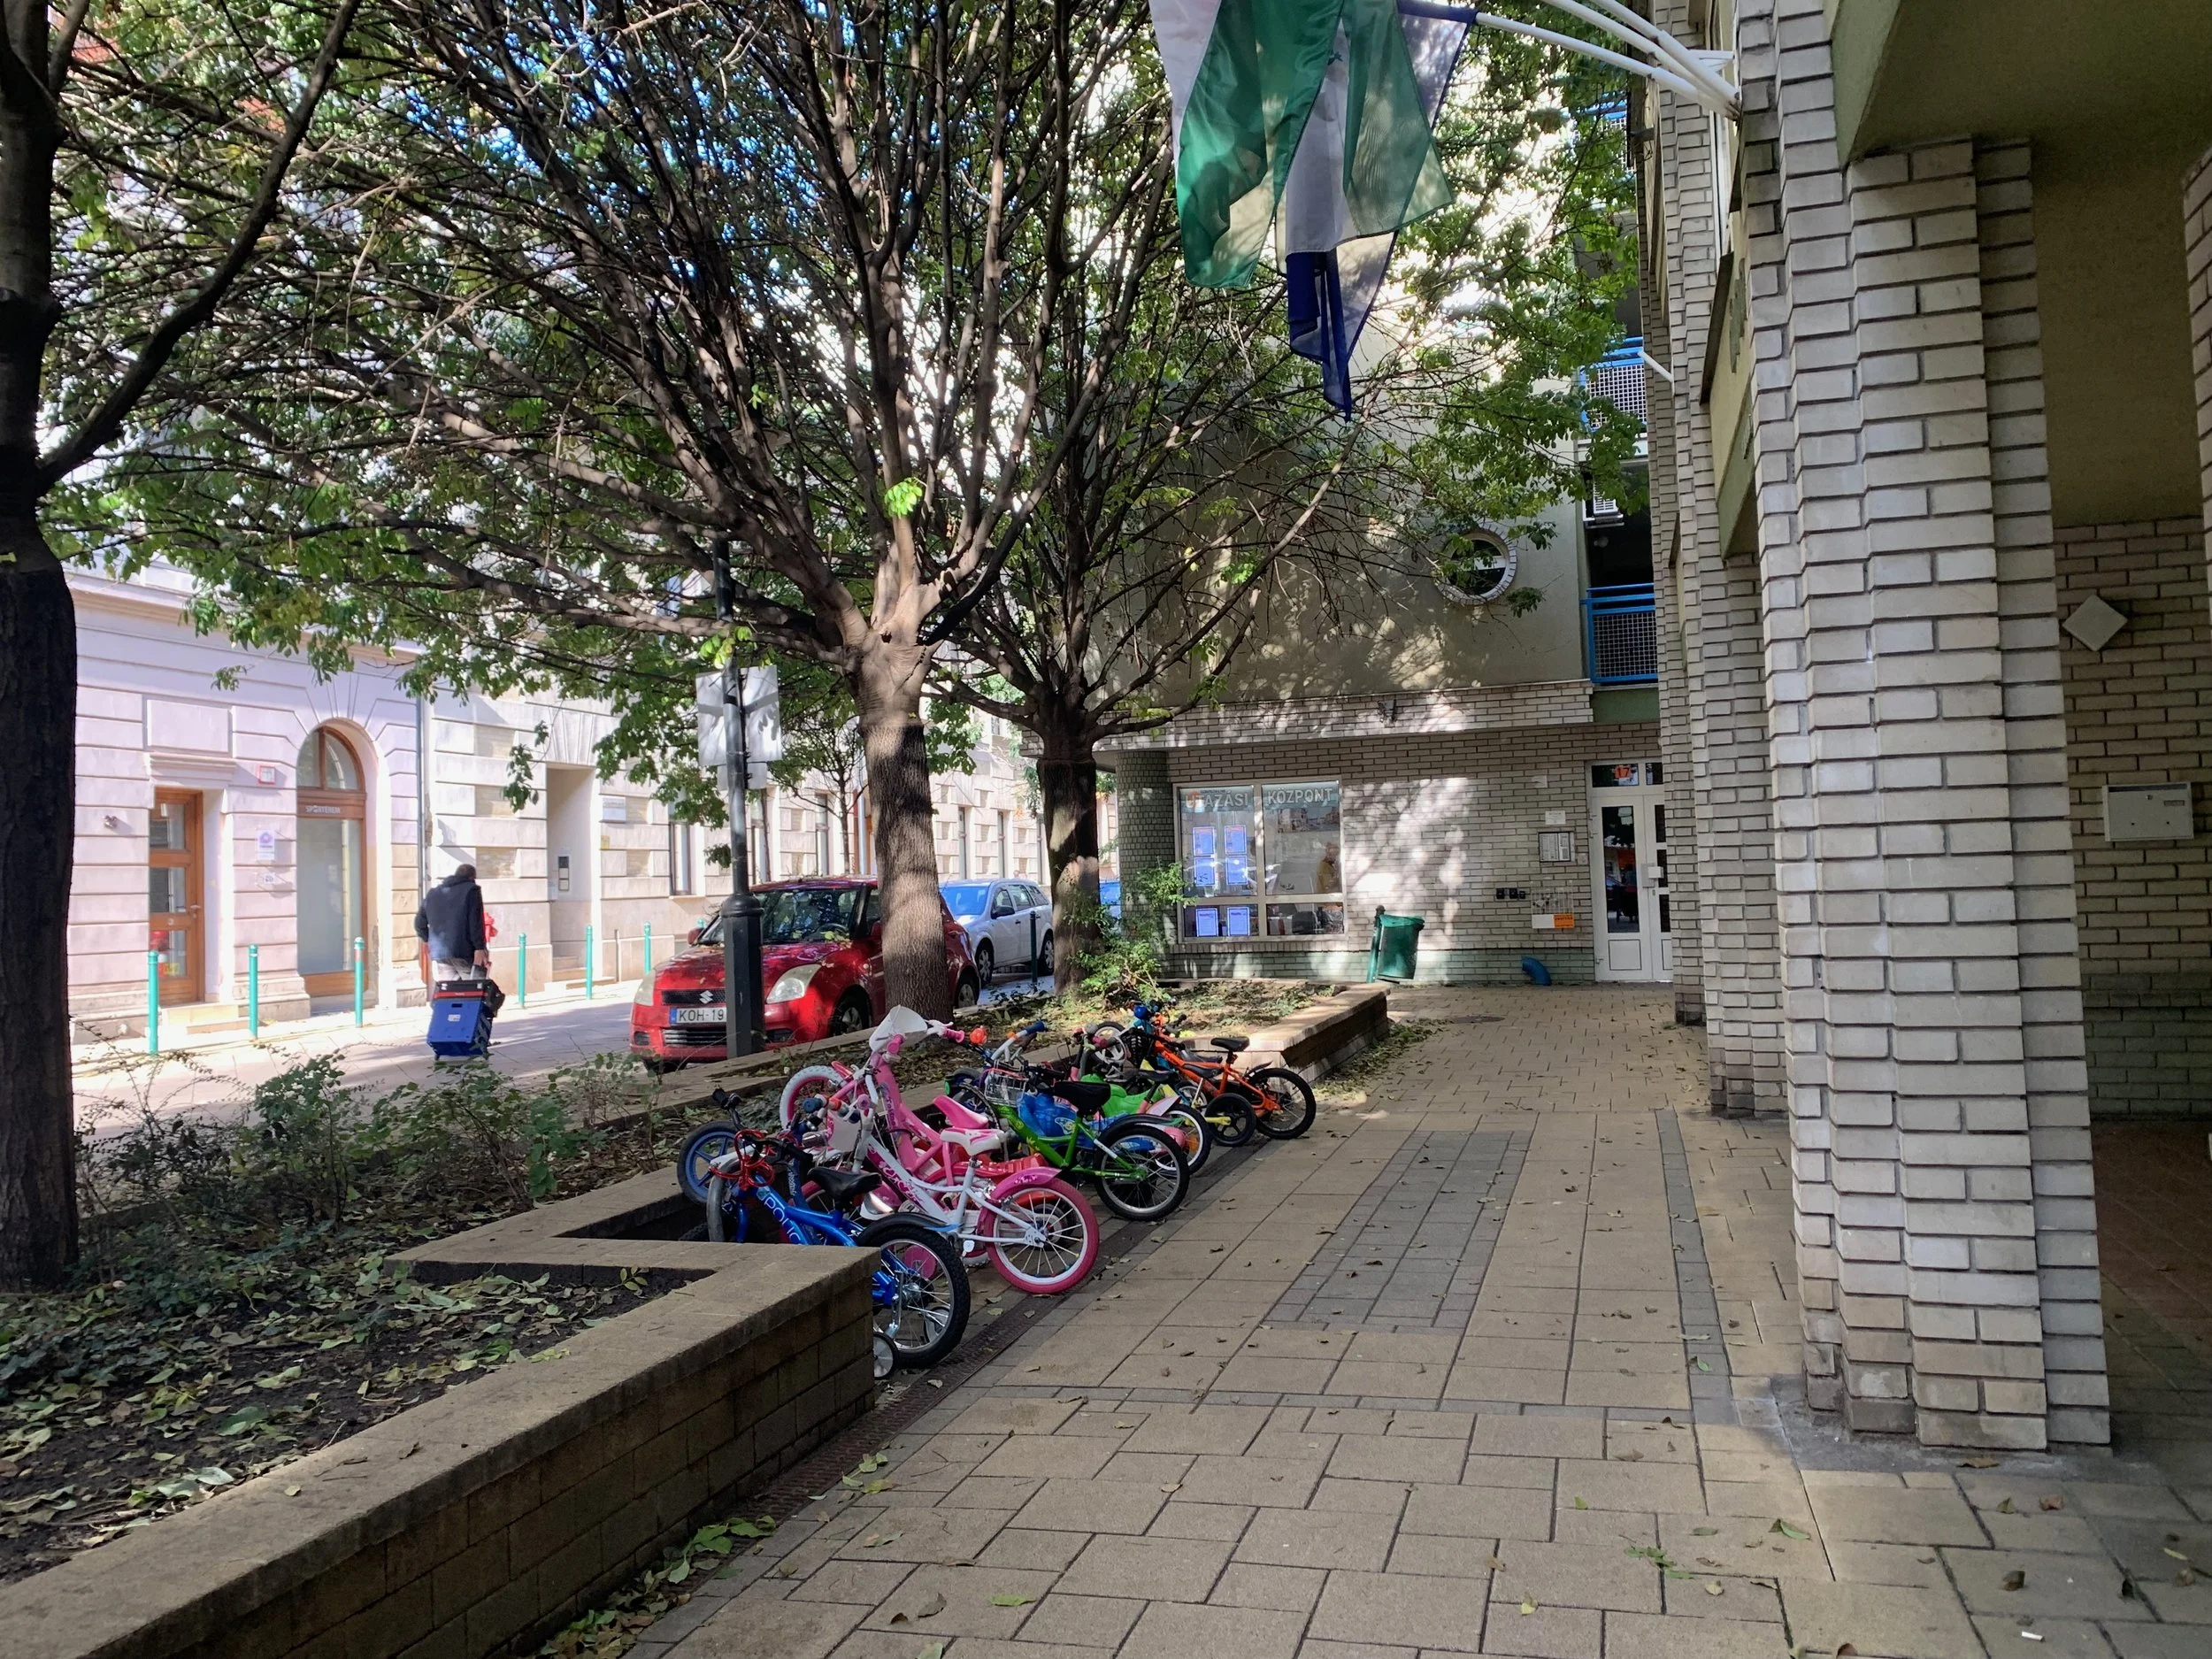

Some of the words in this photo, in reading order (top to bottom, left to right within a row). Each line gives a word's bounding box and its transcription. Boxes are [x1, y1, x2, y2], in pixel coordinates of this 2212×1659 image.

[1617, 766, 1630, 779] 17
[1185, 790, 1248, 810] UTAZÁSI
[1267, 787, 1333, 805] KÖZPONT
[678, 1009, 726, 1022] KOH-19
[764, 1196, 803, 1245] POLIC
